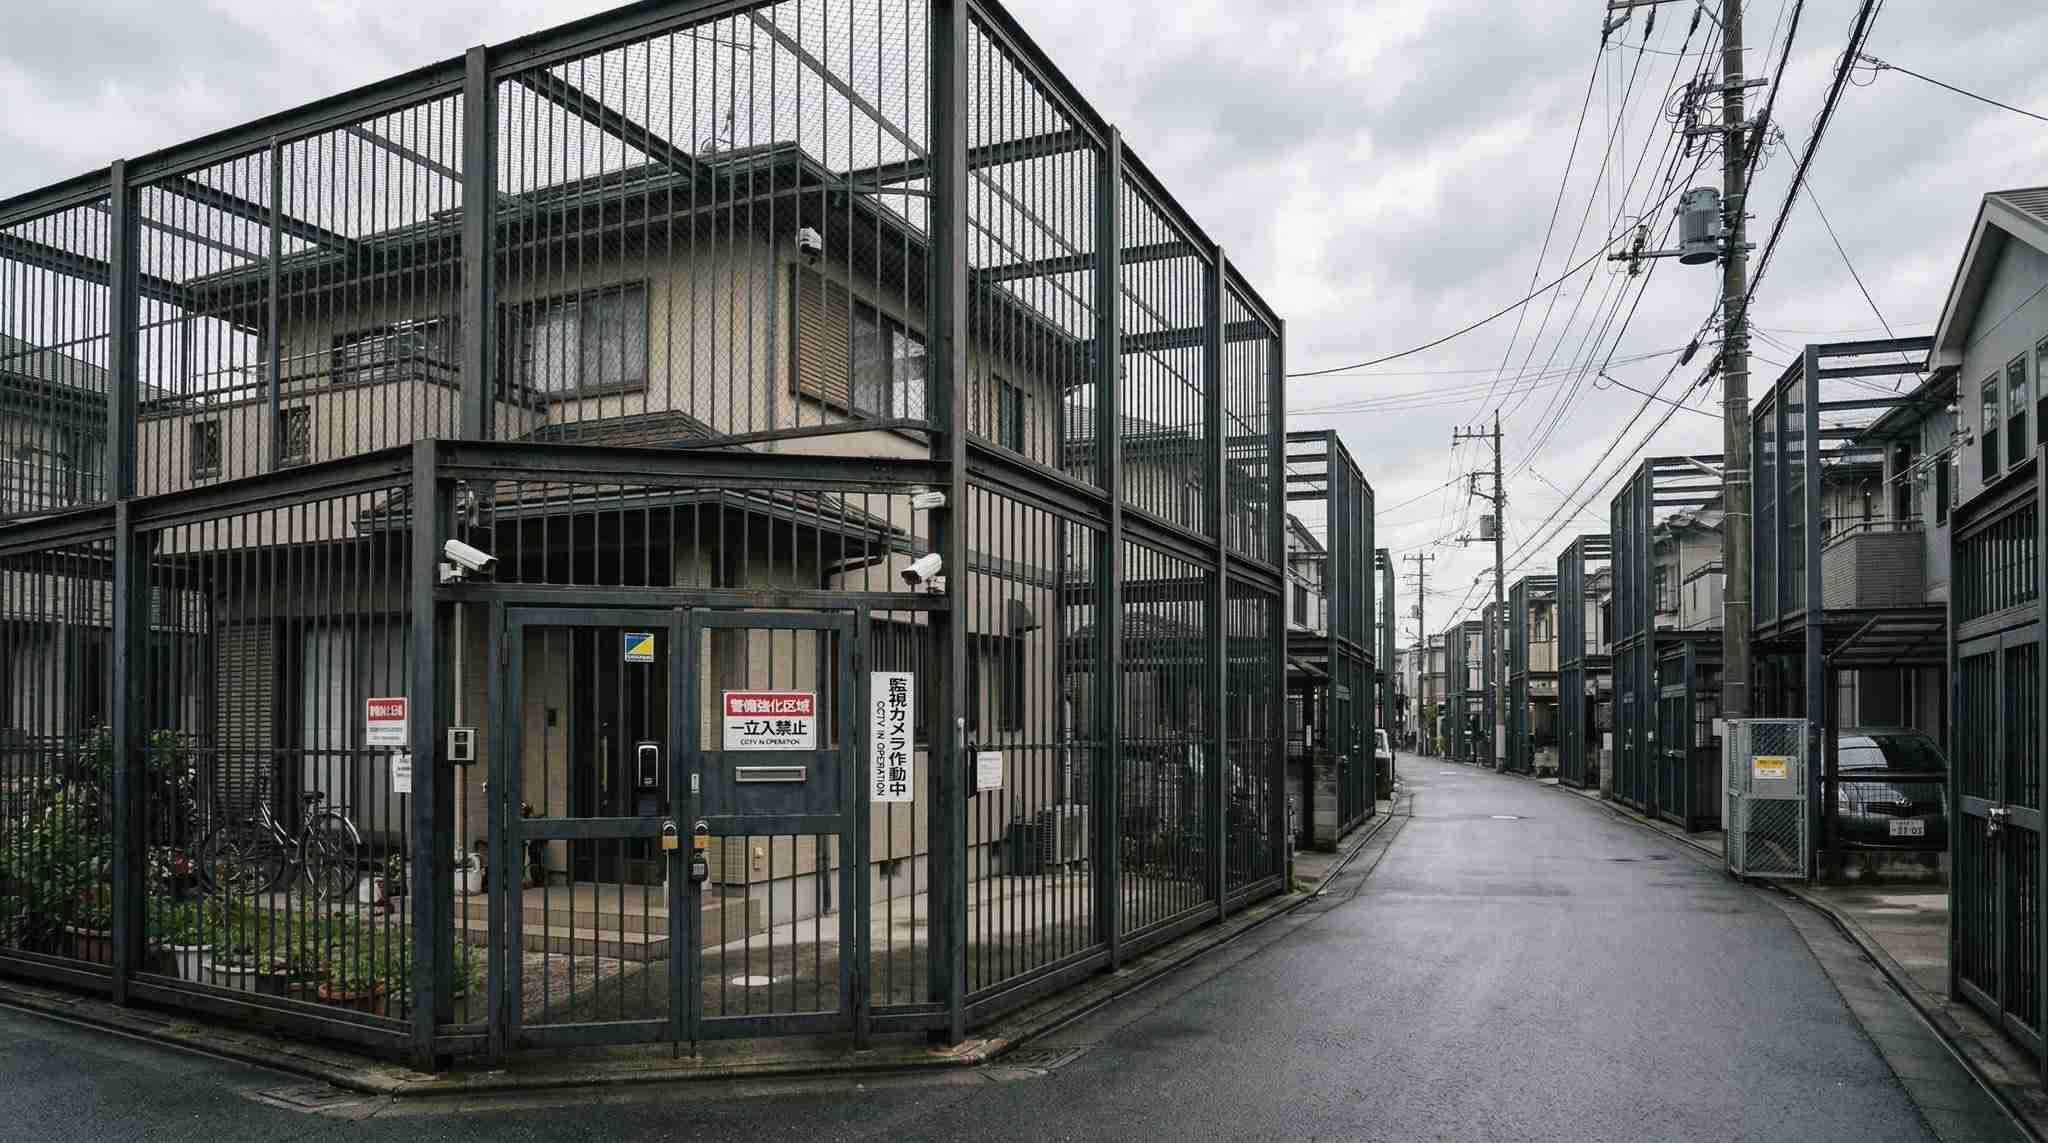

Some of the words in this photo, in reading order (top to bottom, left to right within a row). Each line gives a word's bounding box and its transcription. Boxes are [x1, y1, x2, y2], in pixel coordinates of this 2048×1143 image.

[877, 700, 885, 727] CCTV
[877, 730, 885, 739] IN
[889, 678, 907, 796] 監視カメラ作動中
[877, 742, 885, 796] OPERATION
